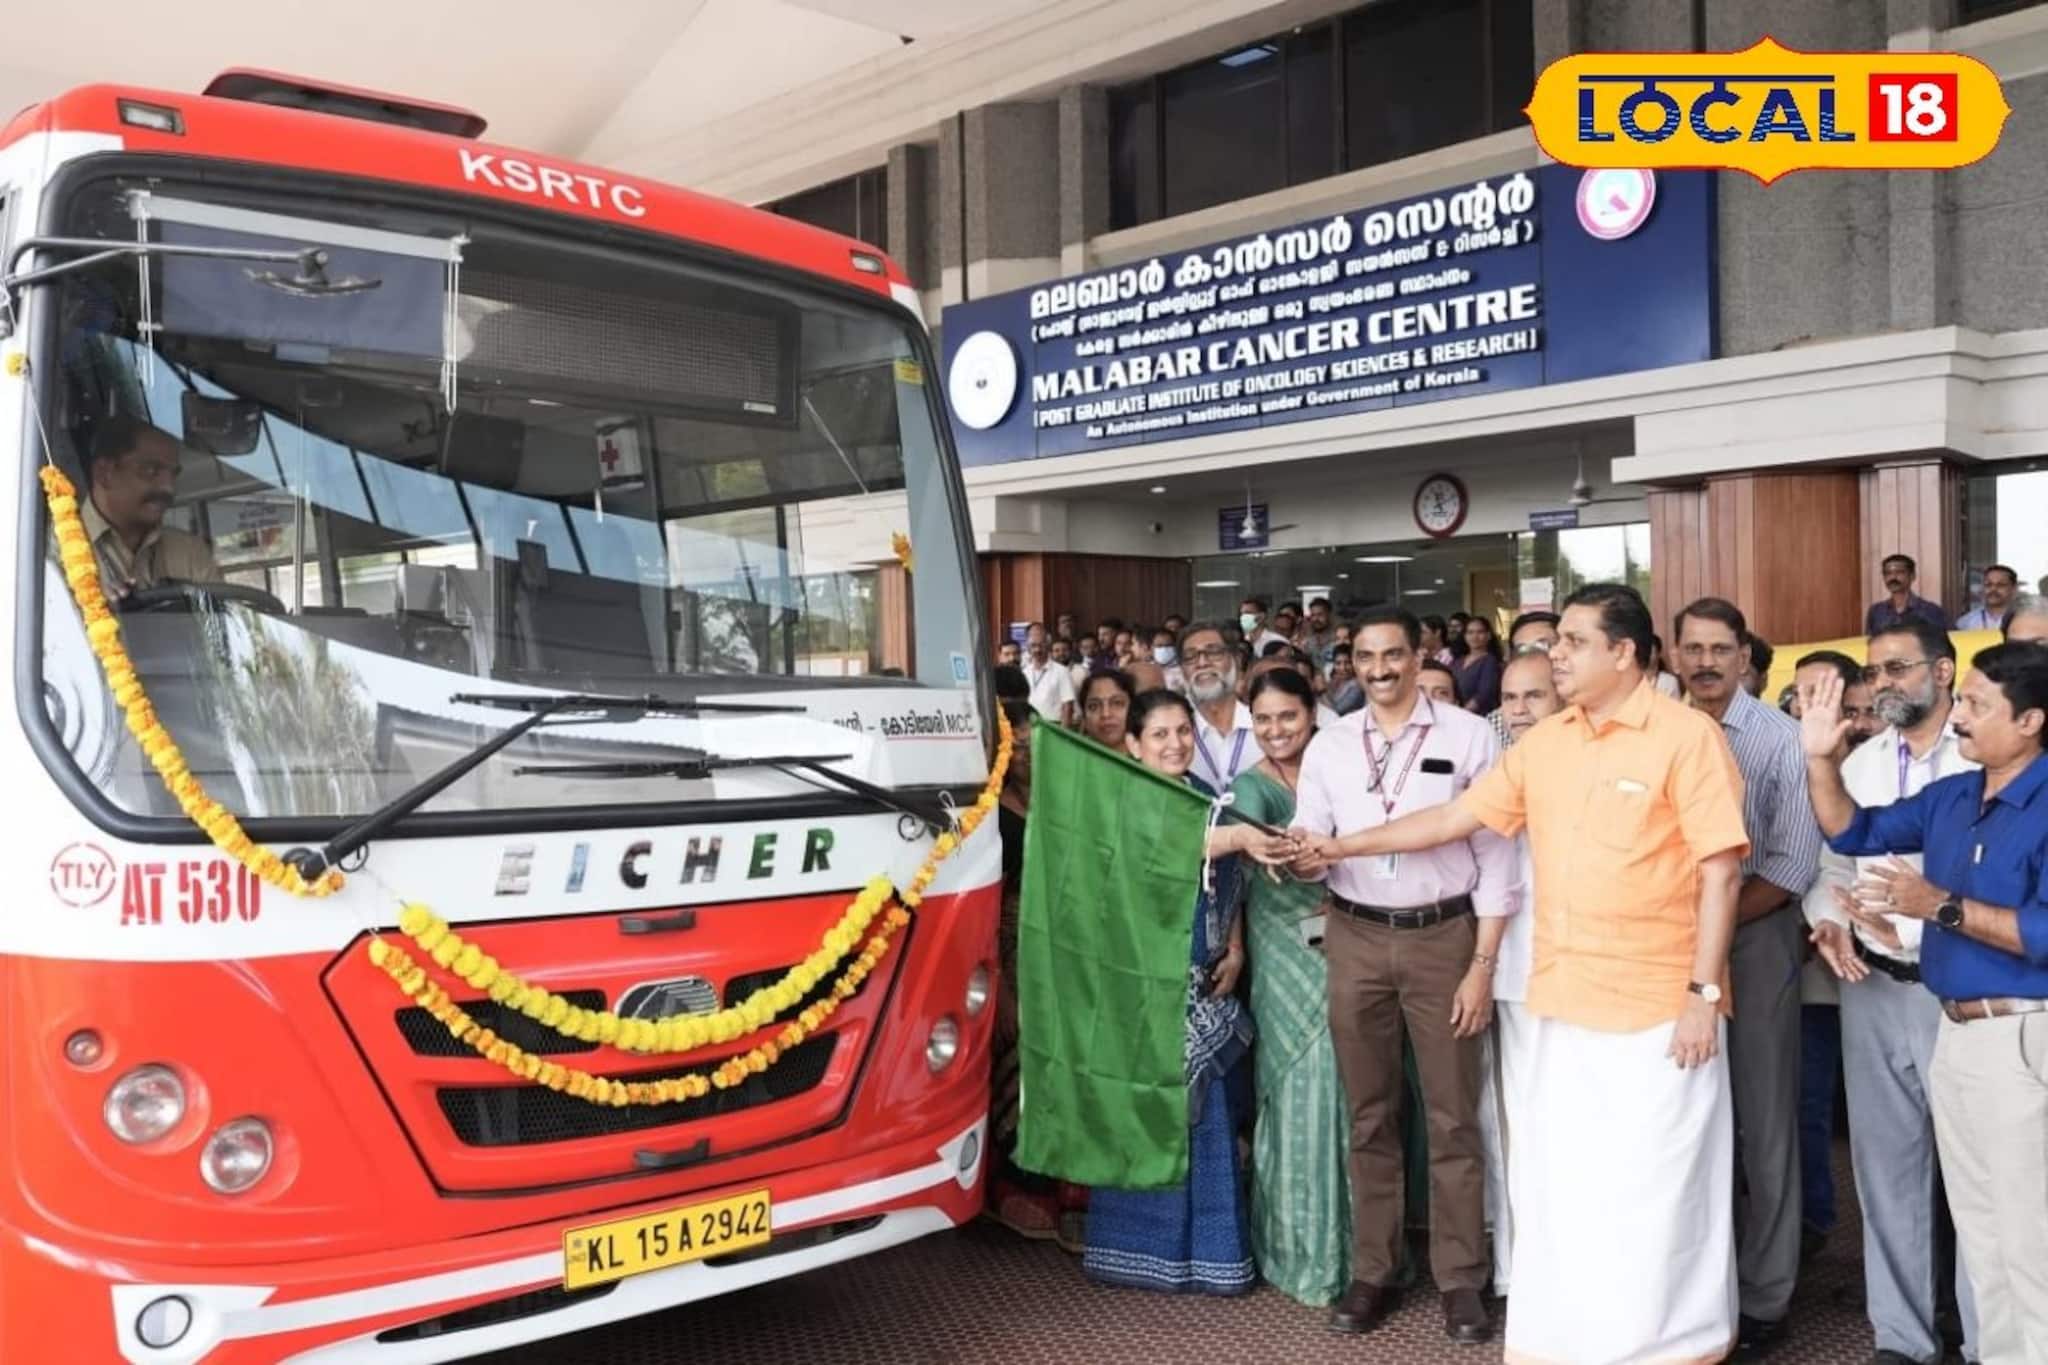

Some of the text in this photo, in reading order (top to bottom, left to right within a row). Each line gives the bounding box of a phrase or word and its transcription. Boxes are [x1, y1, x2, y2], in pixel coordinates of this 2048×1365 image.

[460, 148, 646, 218] KSRTC
[1030, 258, 1166, 319] മലബാർ
[1173, 215, 1352, 288] കാൻസർ
[1031, 283, 1538, 403] MALABAR CANCER CENTRE
[1075, 395, 1147, 421] GRADUATE
[1147, 384, 1220, 411] INSTITUTE
[1222, 383, 1243, 400] OF
[1244, 364, 1328, 395] ONCOLOGY
[1330, 350, 1409, 381] SCIENCES
[1412, 348, 1429, 367] &
[1086, 367, 1479, 438] An Autonomous Institution under Government of Kerala
[57, 859, 108, 890] TLY
[119, 858, 261, 926] AT 530
[494, 827, 835, 896] EICHER
[587, 1201, 767, 1273] KL 15 A 2942
